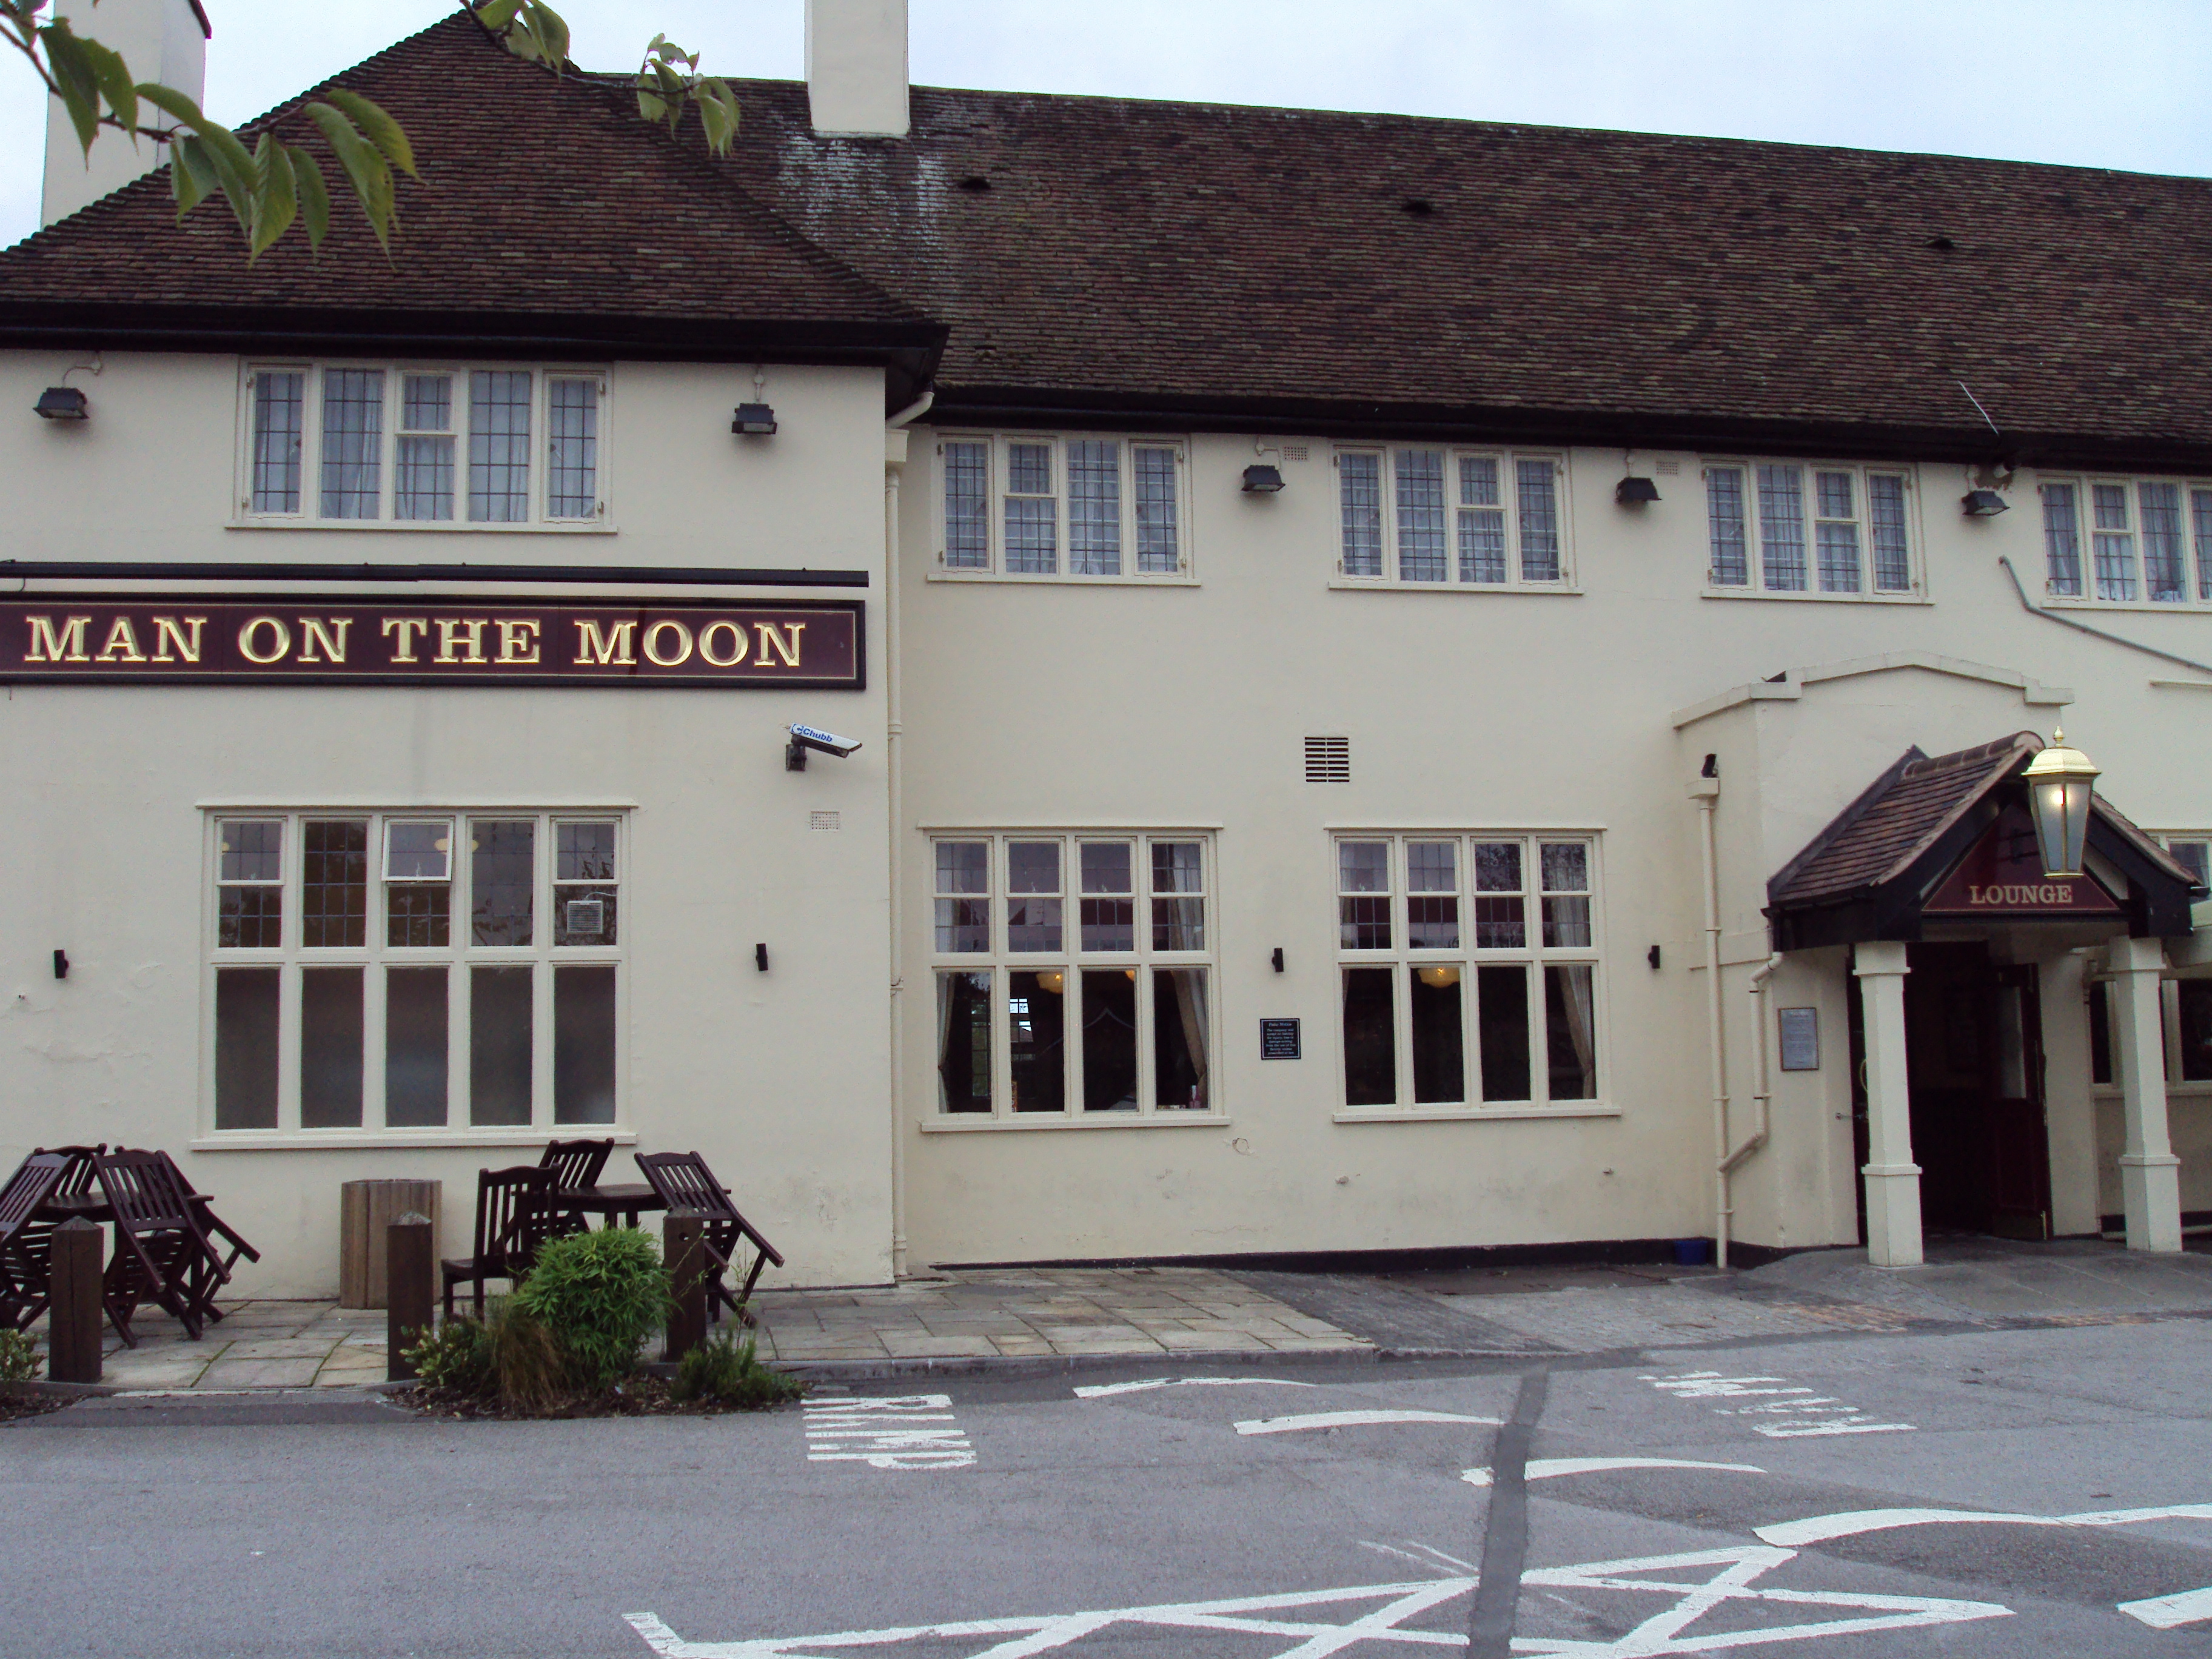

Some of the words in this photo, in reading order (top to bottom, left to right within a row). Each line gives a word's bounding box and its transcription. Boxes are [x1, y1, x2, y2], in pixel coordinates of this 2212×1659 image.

[24, 615, 208, 663] MAN
[238, 616, 353, 664] ON
[382, 617, 541, 664] THE
[573, 619, 806, 667] MOON
[803, 728, 833, 742] Chubb
[1969, 884, 2074, 904] LOUNGE
[800, 1394, 978, 1469] RAMP
